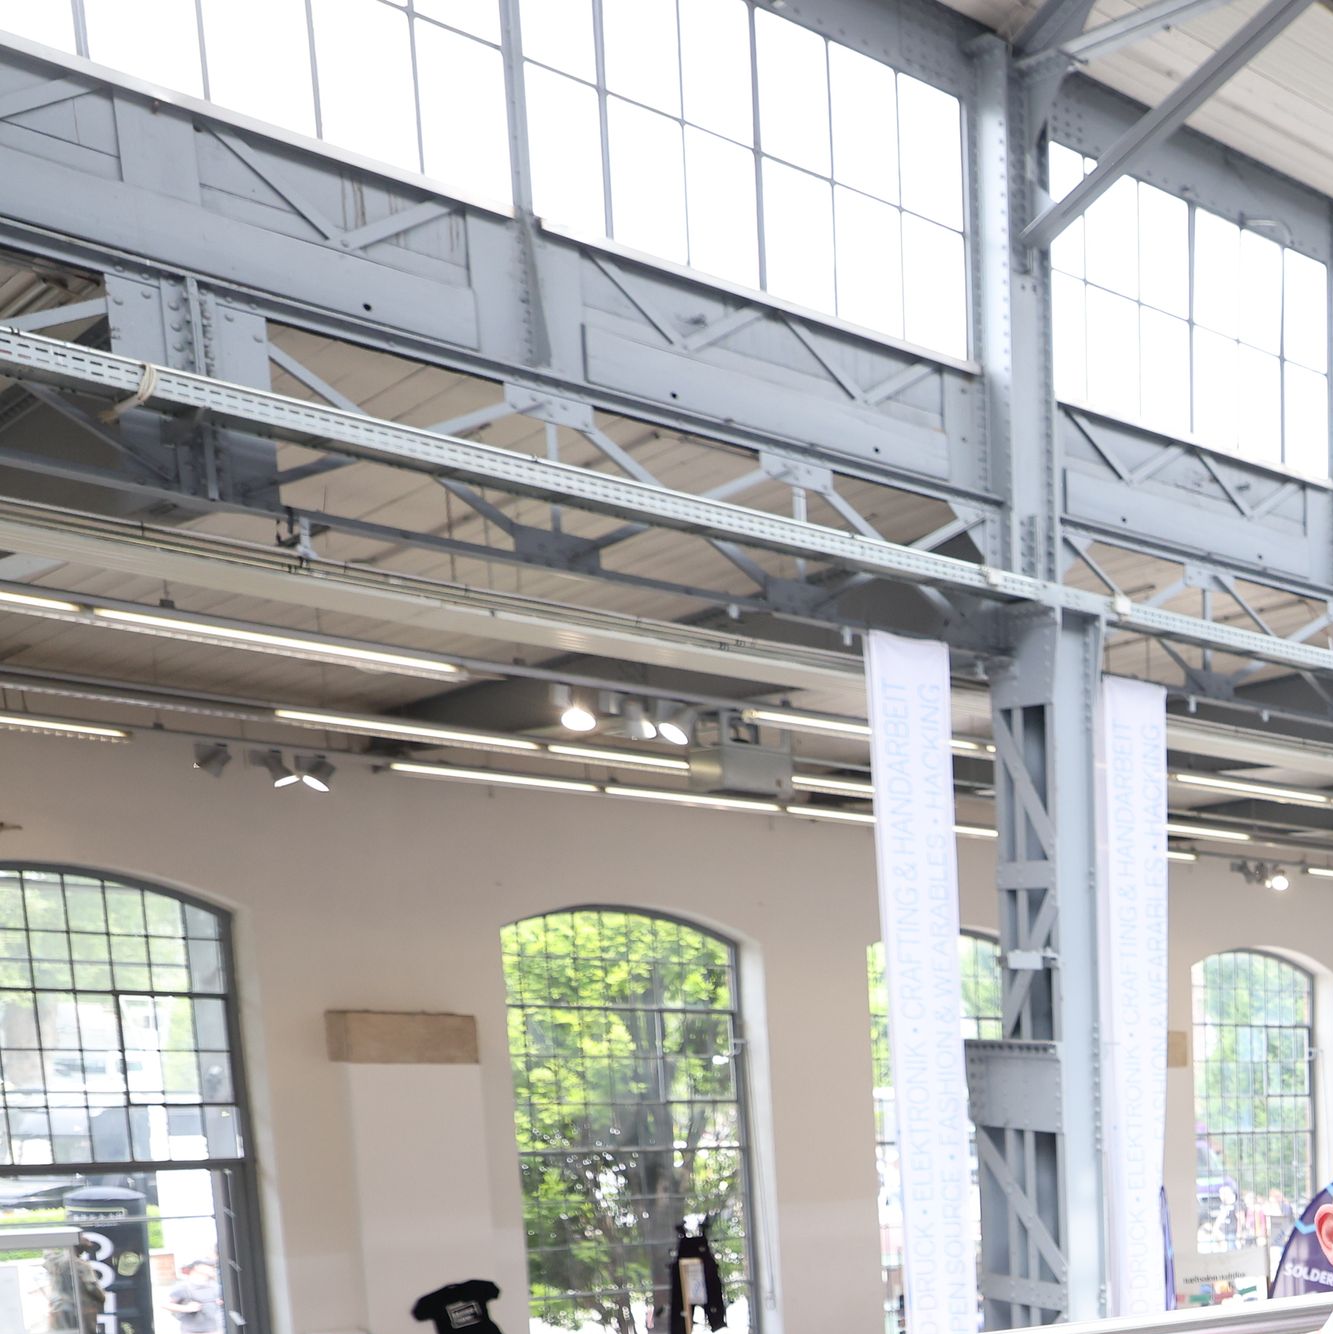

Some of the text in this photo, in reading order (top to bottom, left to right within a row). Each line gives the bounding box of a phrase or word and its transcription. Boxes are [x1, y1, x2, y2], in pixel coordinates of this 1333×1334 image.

[880, 678, 914, 856] HANDARBEIT
[917, 682, 944, 810] HACKING
[1110, 719, 1137, 878] HANDARBEIT
[1140, 724, 1161, 836] HACKING
[893, 862, 918, 881] &
[925, 832, 954, 1000] WEARABLES
[891, 887, 923, 1020] CRAFTING
[1119, 905, 1140, 1026] CRAFTING
[903, 1043, 933, 1200] ELEKTRONIK
[935, 1030, 960, 1146] FASHION
[1120, 1046, 1145, 1191] ELEKTRONIK
[940, 1170, 964, 1274] SOURCE
